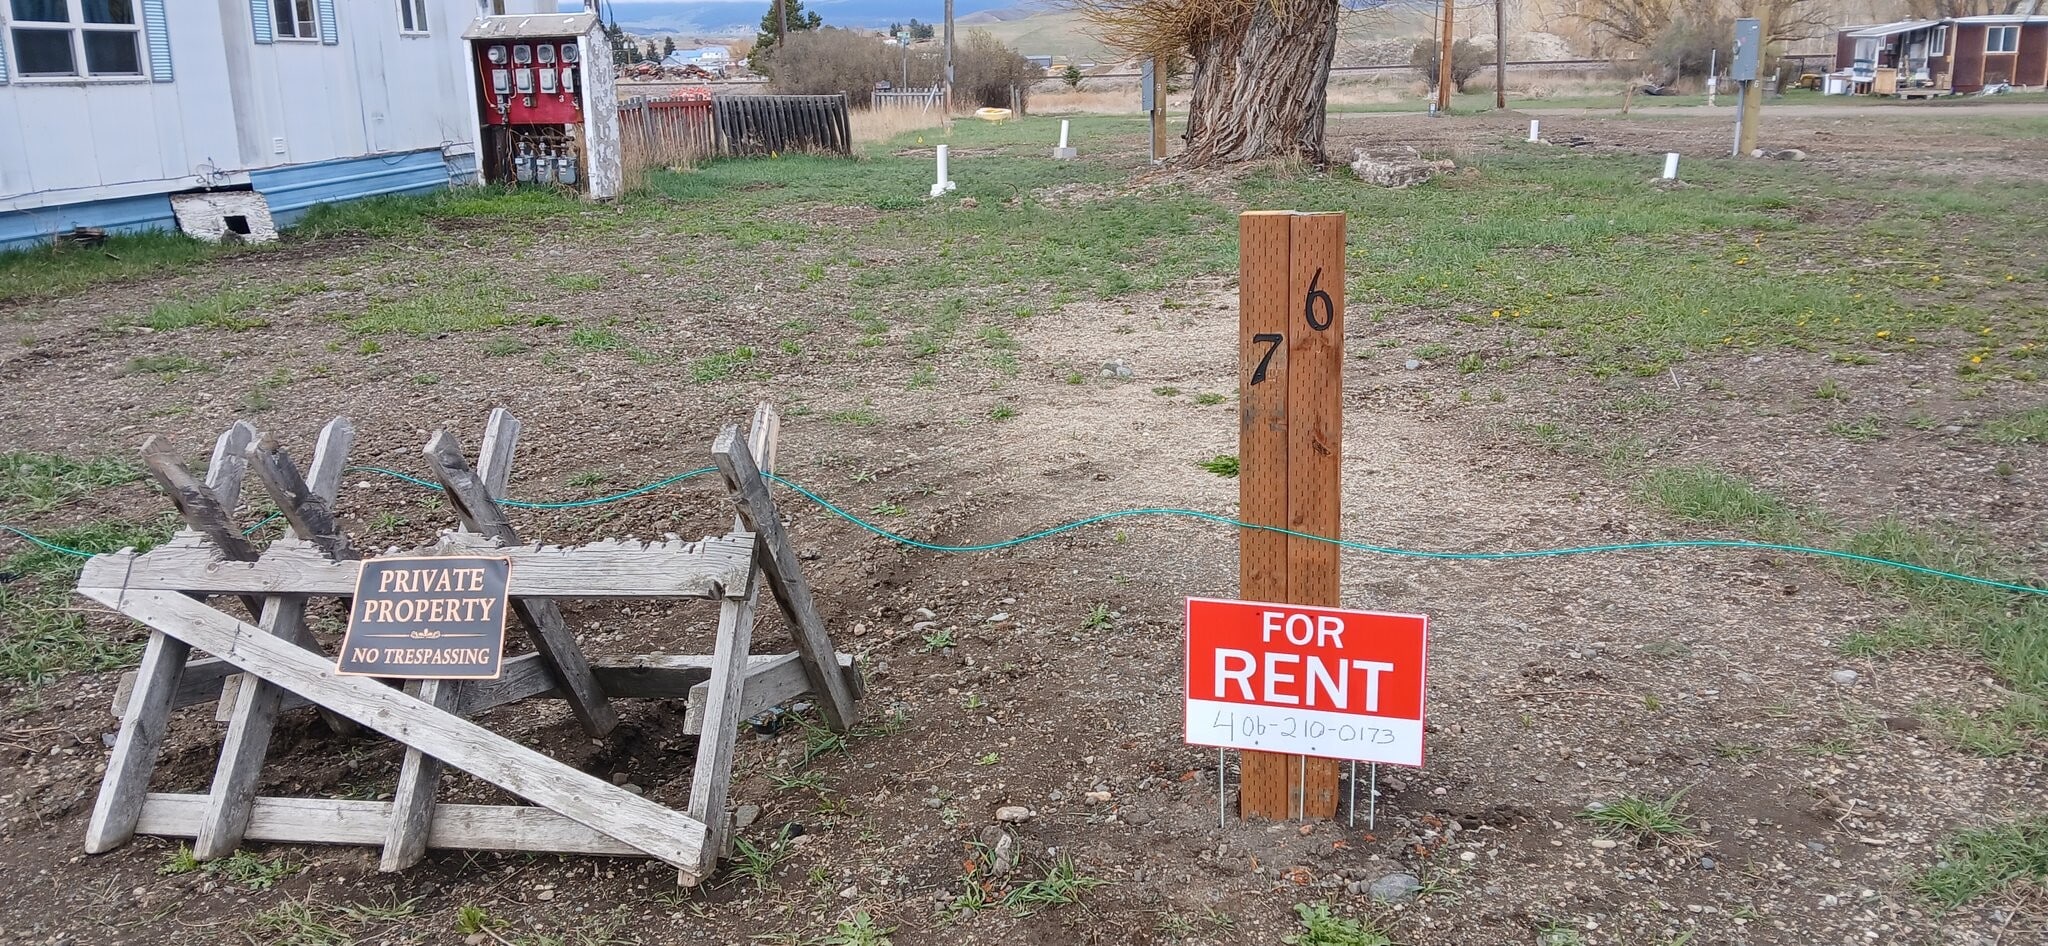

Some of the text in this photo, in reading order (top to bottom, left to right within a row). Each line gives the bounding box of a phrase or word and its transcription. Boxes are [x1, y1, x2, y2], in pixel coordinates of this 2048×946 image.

[1305, 267, 1334, 331] 6
[1250, 333, 1283, 386] 7
[378, 568, 485, 593] PRIVATE
[361, 597, 496, 623] PROPERTY
[1262, 611, 1345, 649] FOR
[351, 647, 490, 665] NO TRESPASSING
[1214, 647, 1394, 713] RENT
